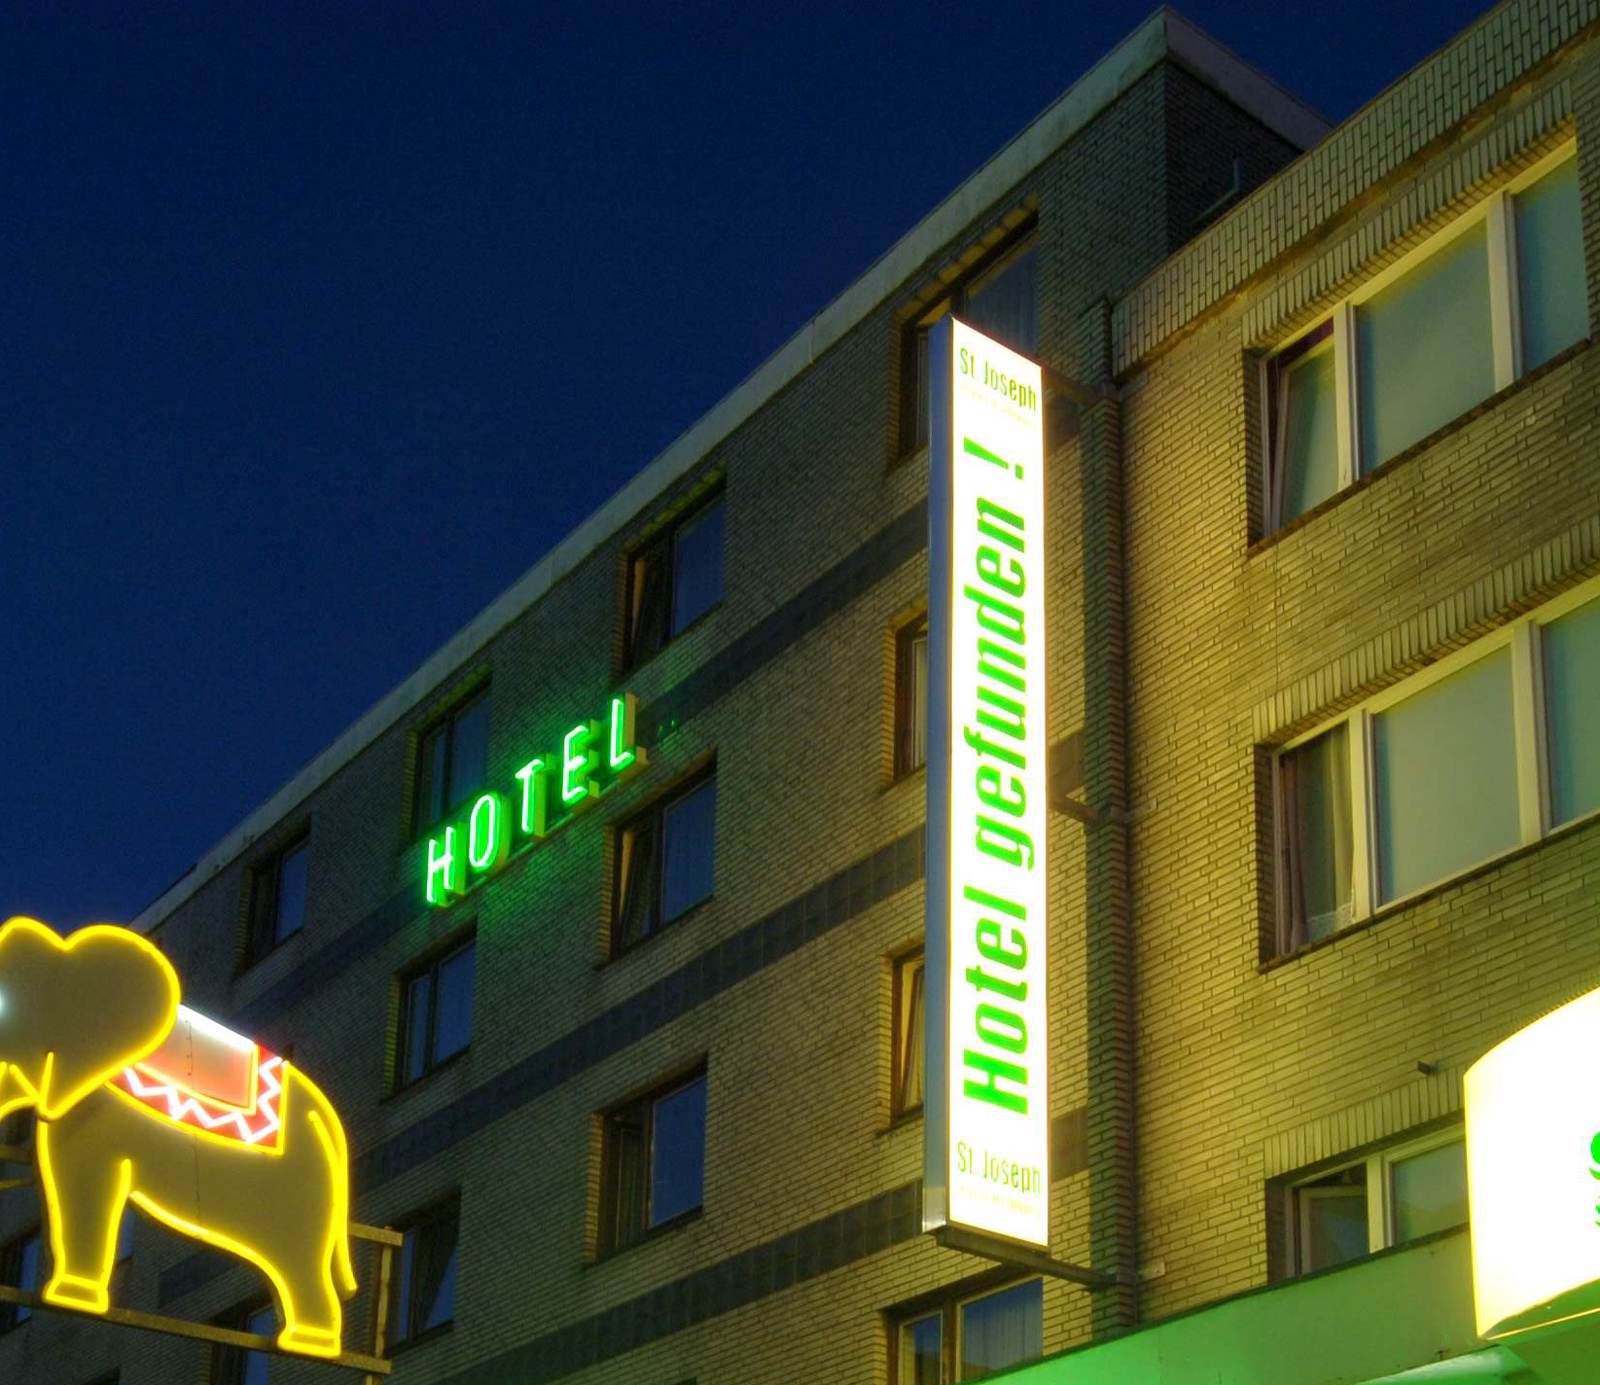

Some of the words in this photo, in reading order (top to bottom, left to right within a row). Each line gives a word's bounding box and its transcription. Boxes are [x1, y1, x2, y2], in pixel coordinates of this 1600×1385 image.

[959, 347, 975, 379] St
[983, 359, 1037, 414] Joseph
[963, 496, 1035, 872] gefunden
[425, 697, 637, 906] HOTEL
[963, 883, 1031, 1117] Hotel
[956, 1139, 974, 1176] St
[983, 1149, 1041, 1196] Joseph
